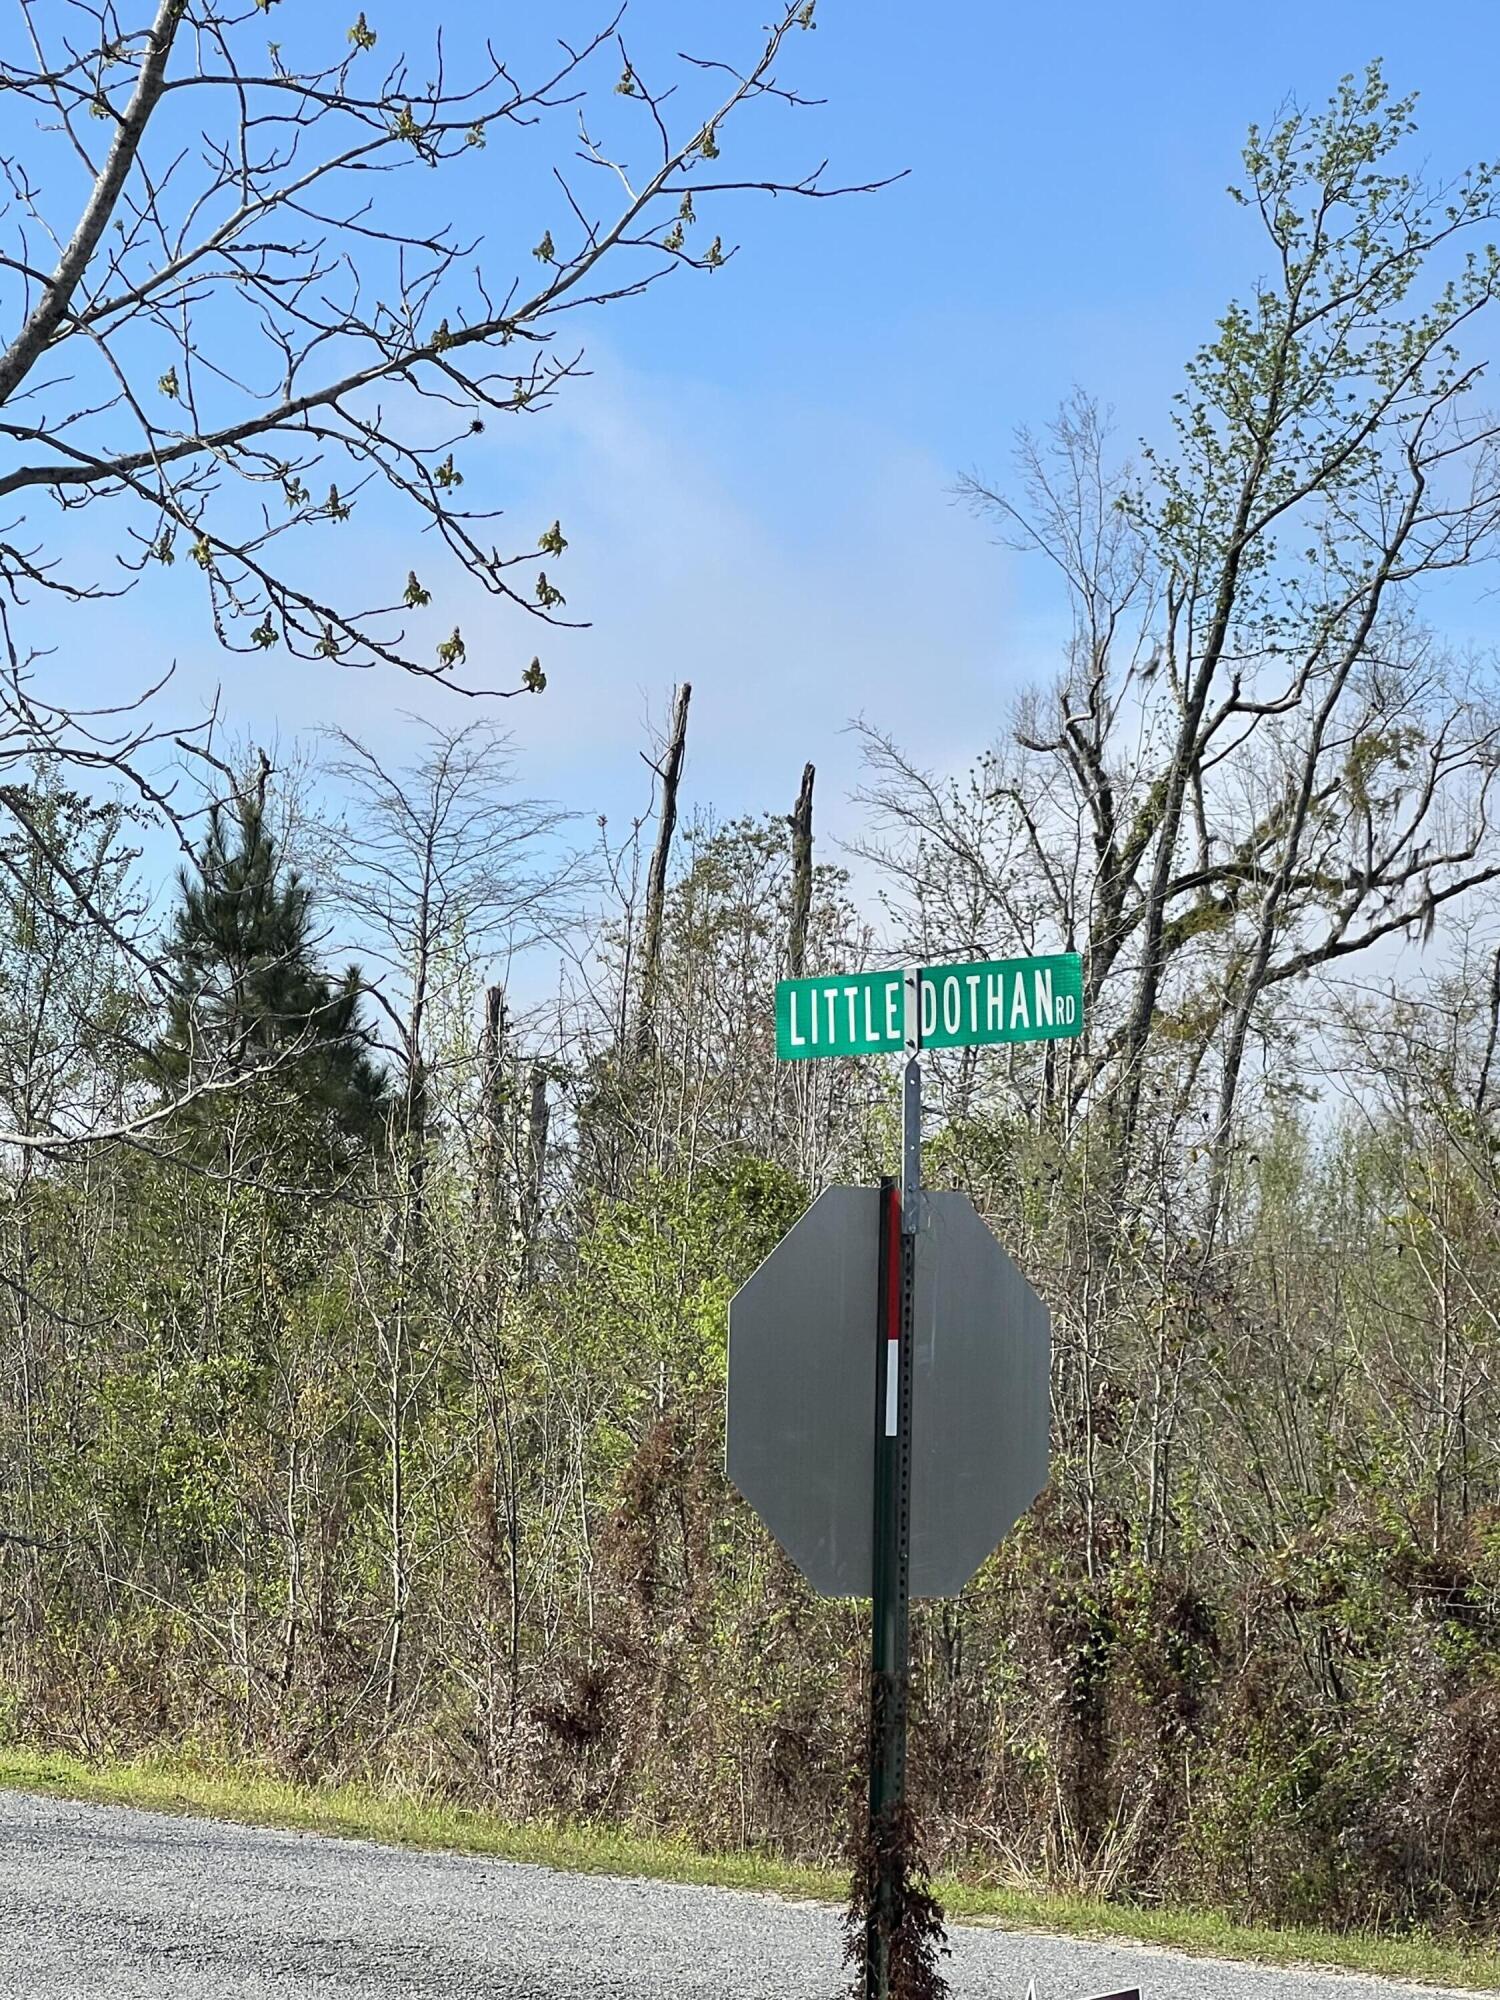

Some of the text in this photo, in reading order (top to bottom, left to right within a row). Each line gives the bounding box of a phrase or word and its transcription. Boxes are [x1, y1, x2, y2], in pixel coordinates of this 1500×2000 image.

[790, 969, 1075, 1045] LITTLE DOTHAN RD
